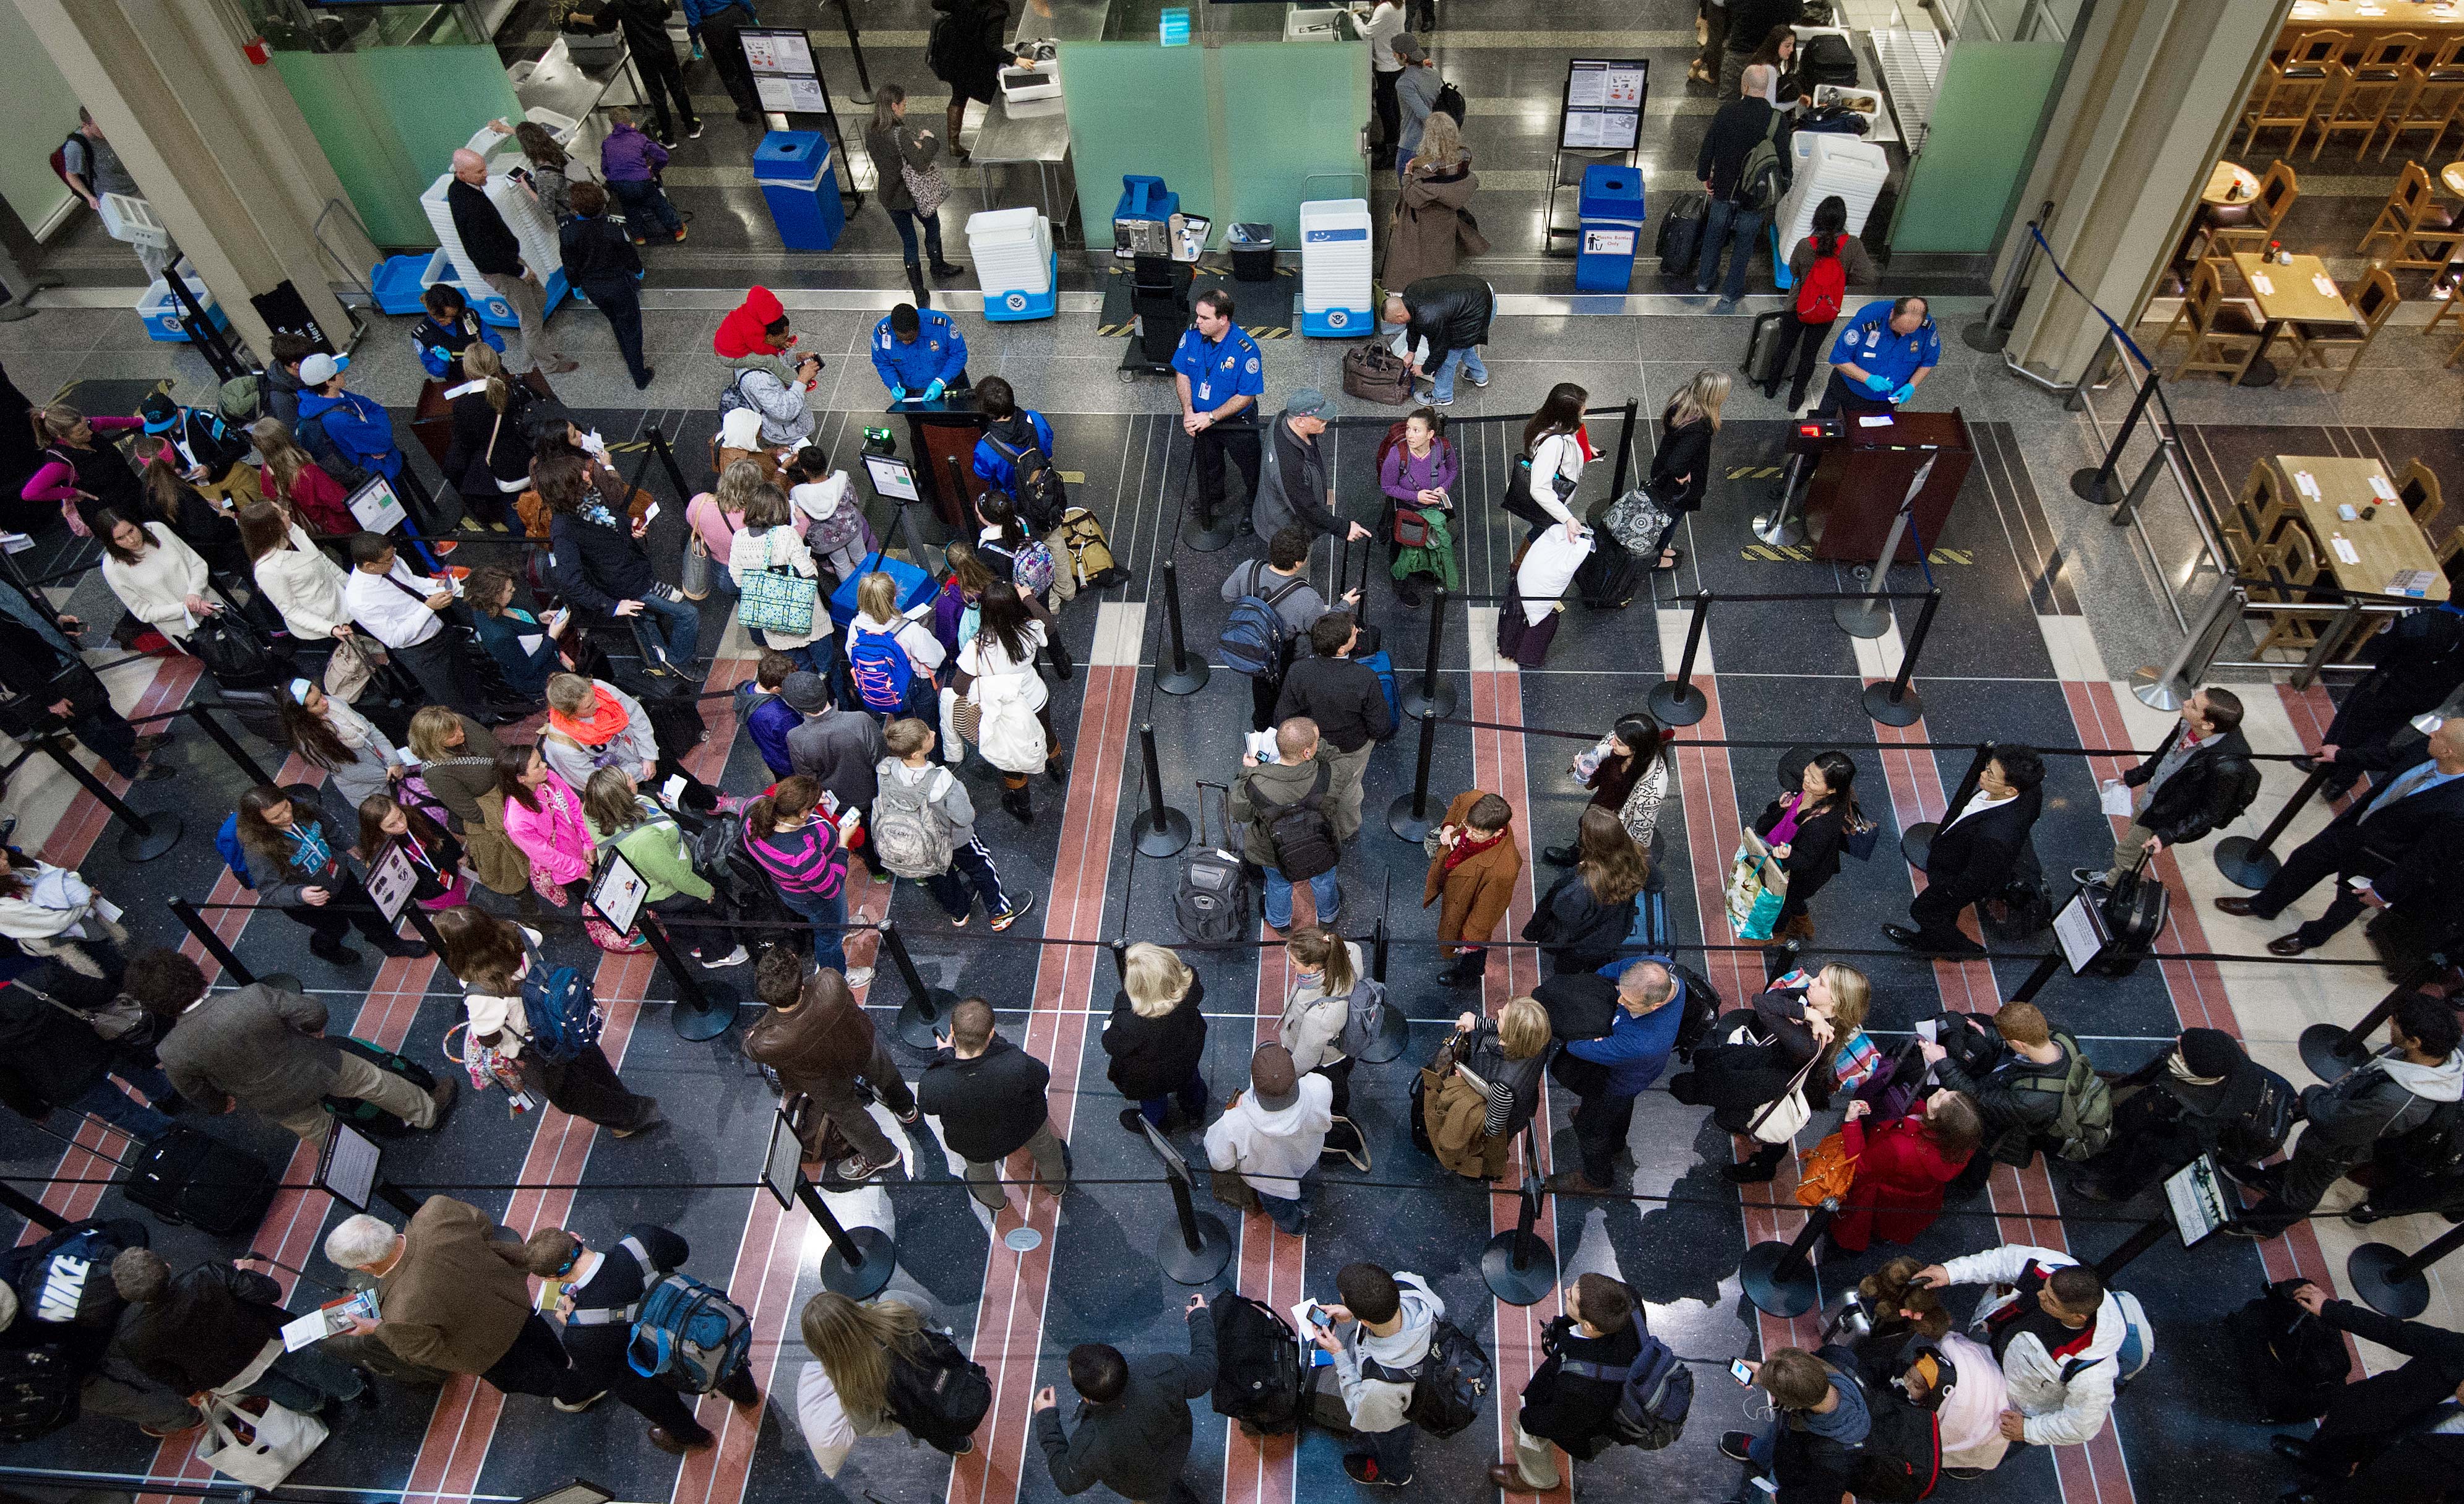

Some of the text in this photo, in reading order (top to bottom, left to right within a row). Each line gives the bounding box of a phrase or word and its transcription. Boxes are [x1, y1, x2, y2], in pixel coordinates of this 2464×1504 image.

[306, 322, 323, 343] Here
[290, 820, 322, 866] ASHORD
[592, 873, 607, 900] Hey Kids!
[38, 1254, 91, 1322] NIKE
